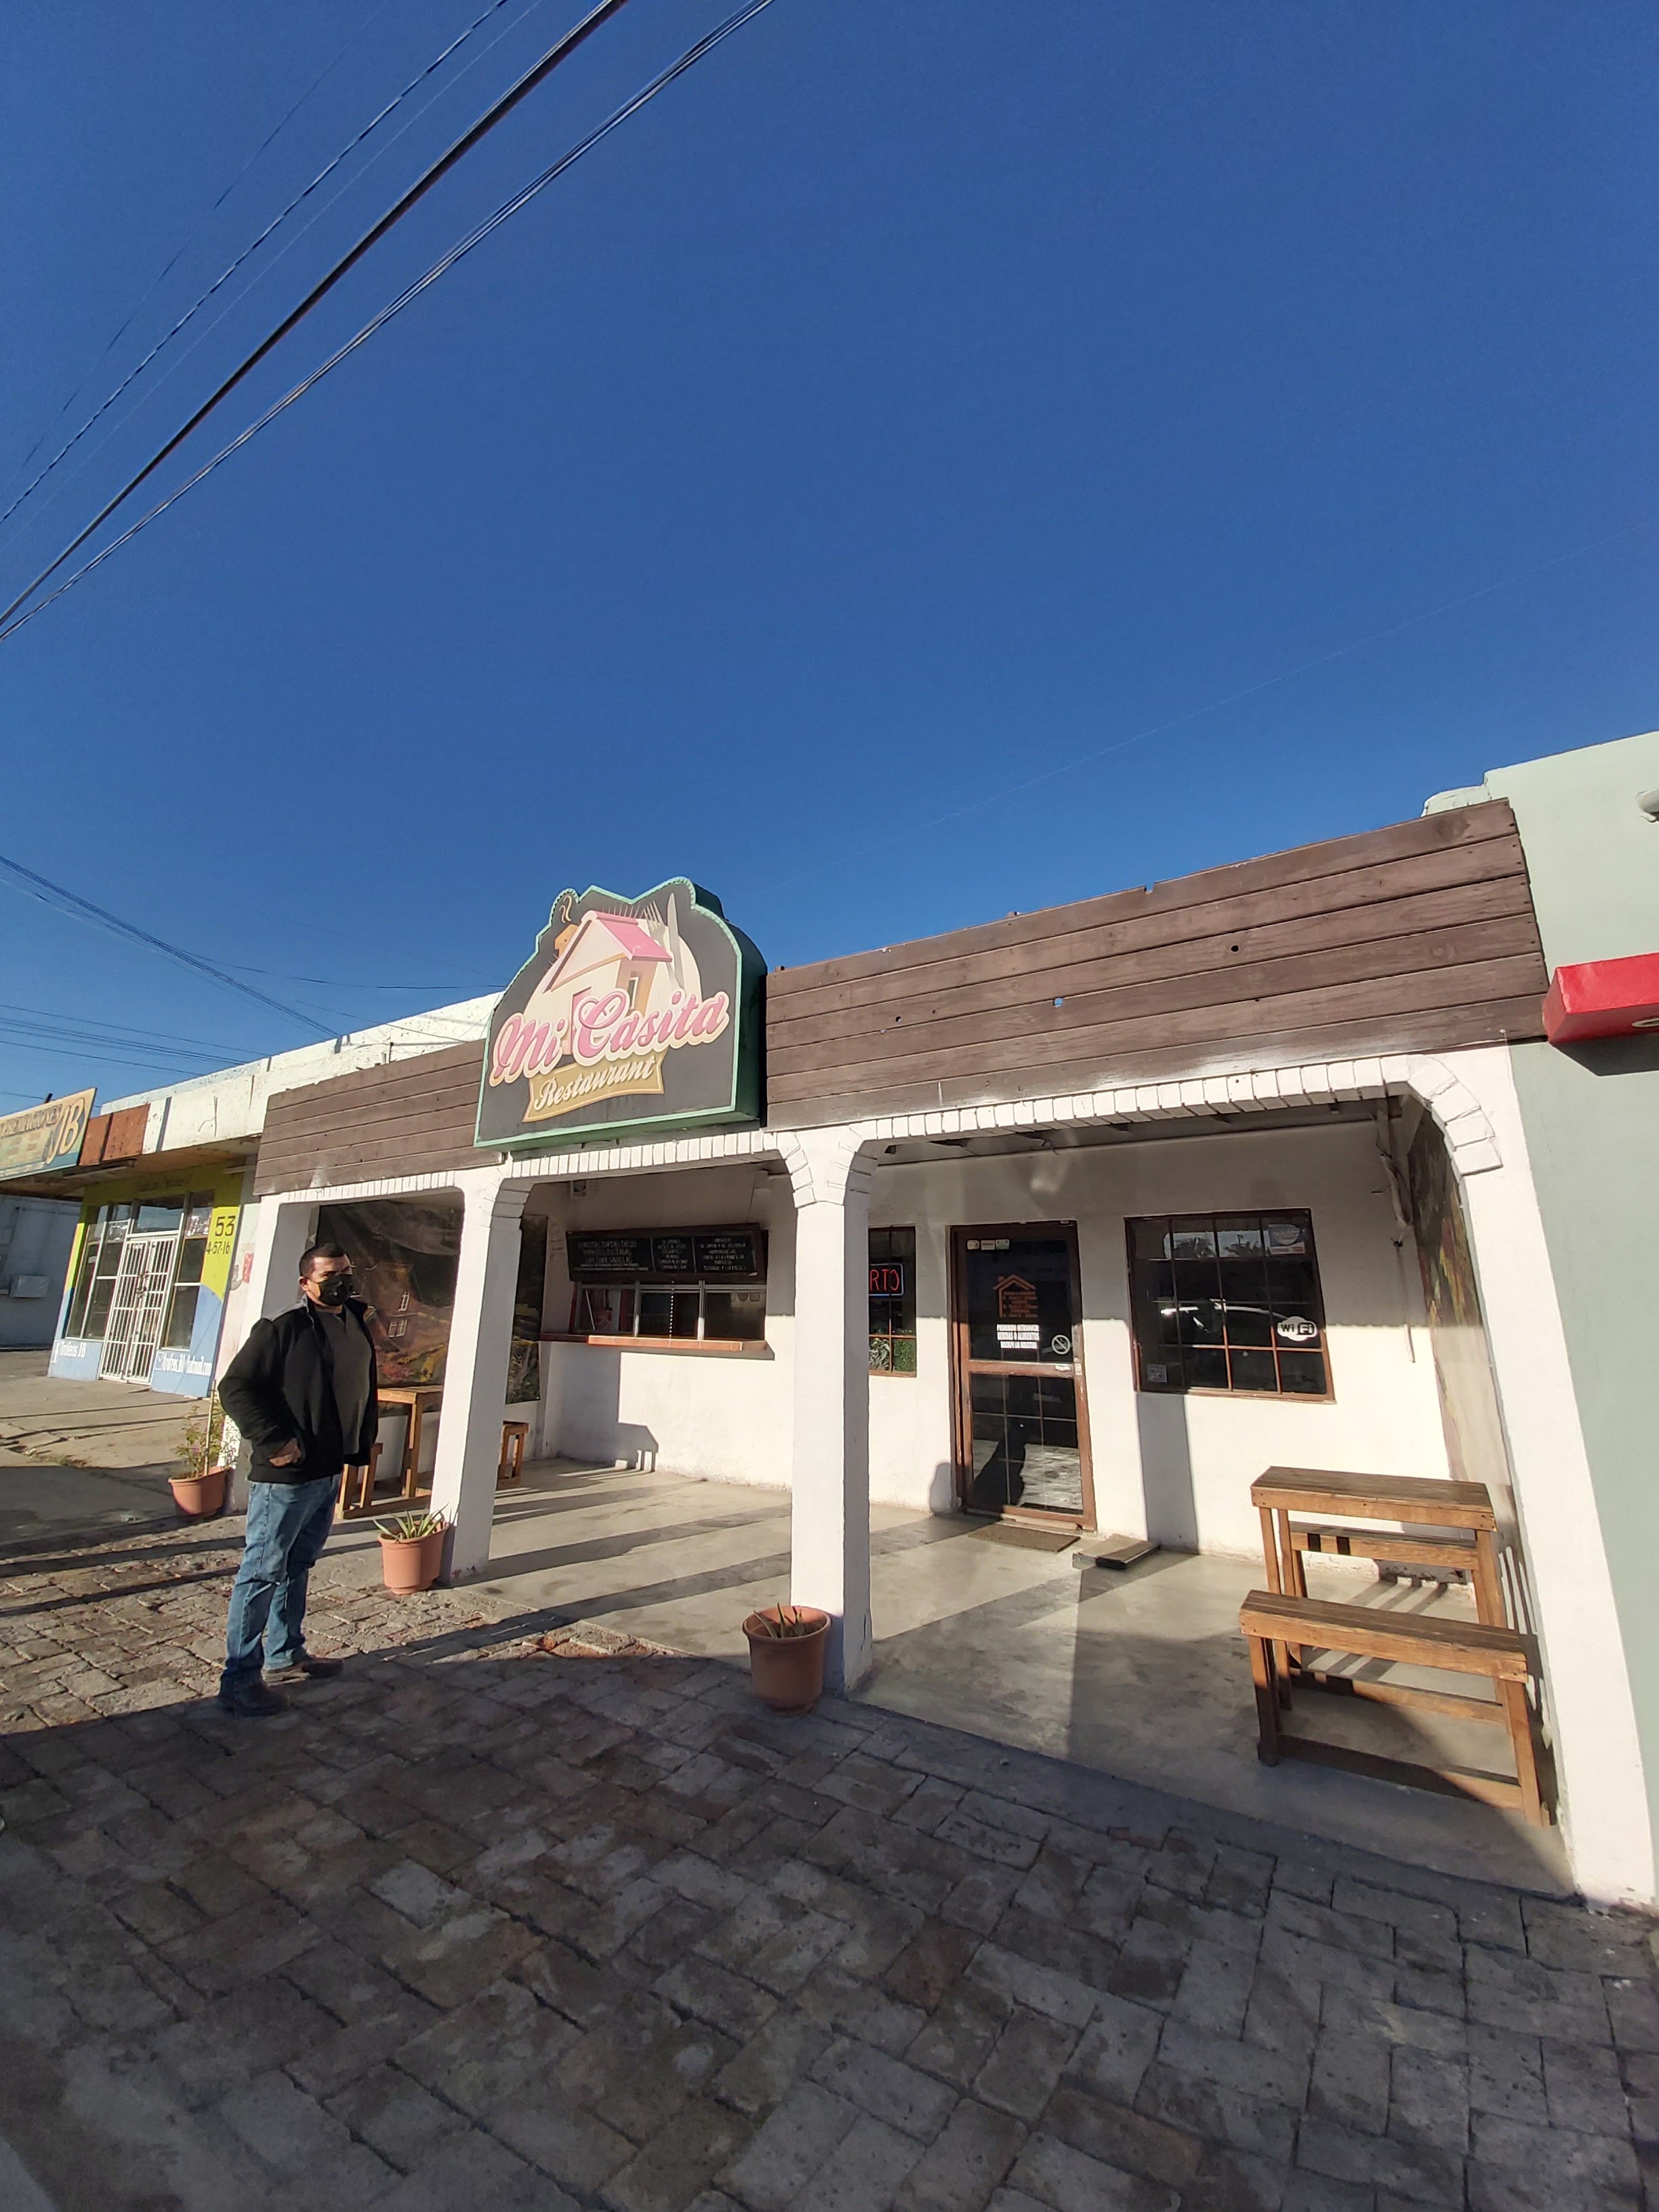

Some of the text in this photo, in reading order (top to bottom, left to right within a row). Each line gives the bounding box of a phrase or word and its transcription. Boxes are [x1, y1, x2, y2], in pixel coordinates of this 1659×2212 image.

[491, 989, 729, 1084] Mi Casita
[533, 1053, 657, 1111] Restaurant
[45, 1097, 85, 1165] JB
[215, 1215, 237, 1237] 53
